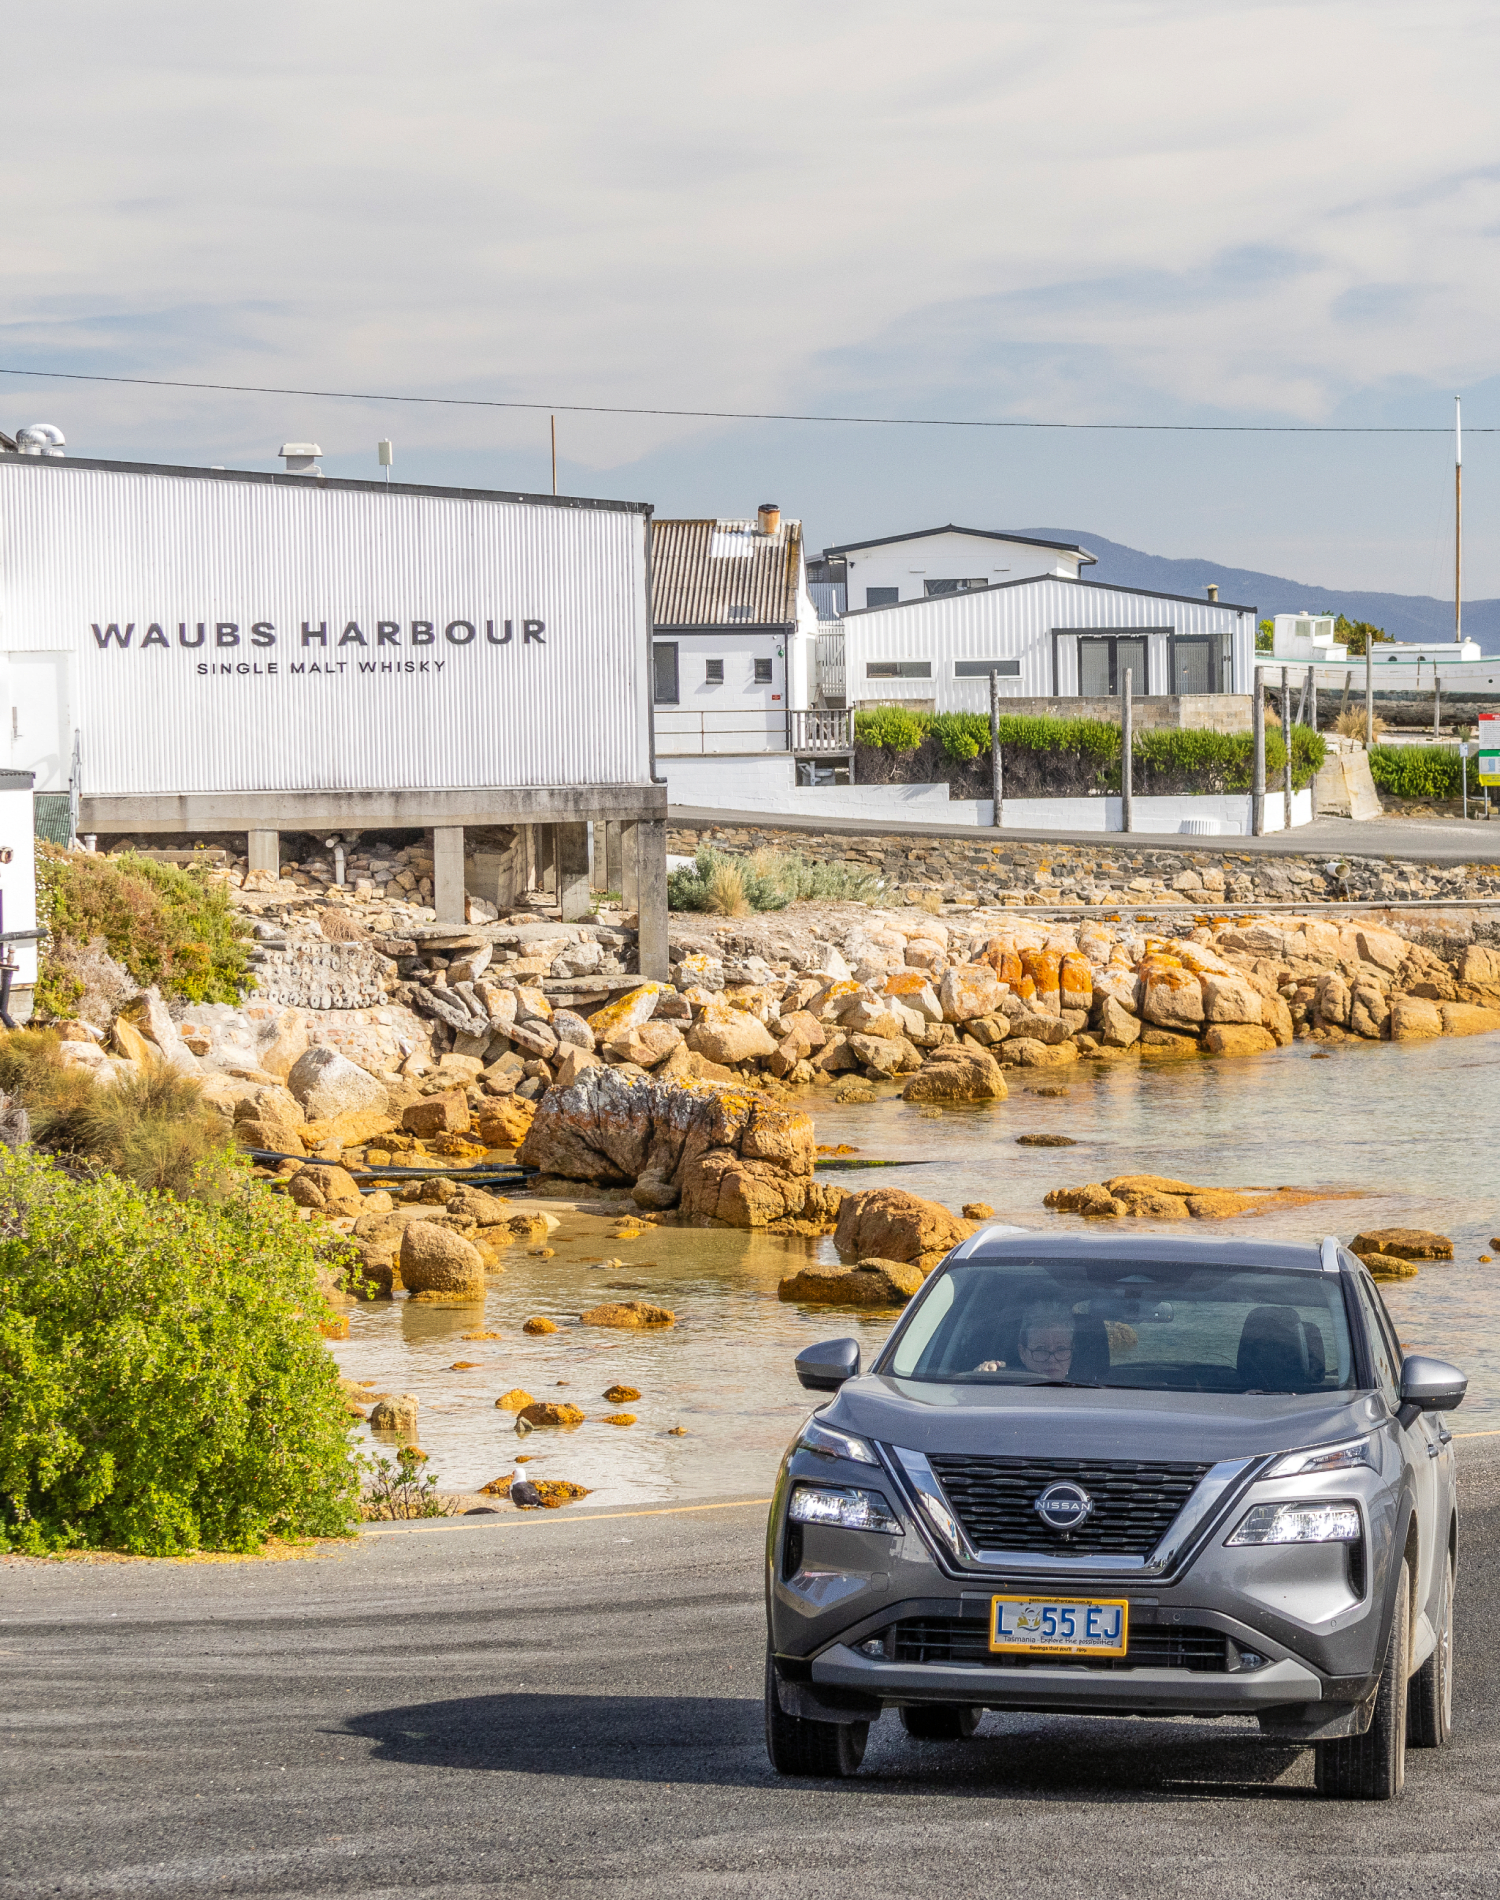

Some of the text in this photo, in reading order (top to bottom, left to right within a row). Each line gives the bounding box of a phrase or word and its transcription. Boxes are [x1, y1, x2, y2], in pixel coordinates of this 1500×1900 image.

[91, 619, 547, 649] WAUBS HARBOUR
[196, 660, 446, 675] SINGLE MALT WHISKY
[1036, 1501, 1091, 1511] NISSAN
[997, 1605, 1121, 1639] L 55 EJ
[1003, 1635, 1036, 1644] Tasmania
[1041, 1636, 1063, 1645] Explore
[1065, 1636, 1078, 1645] the
[1079, 1637, 1115, 1647] possibilities
